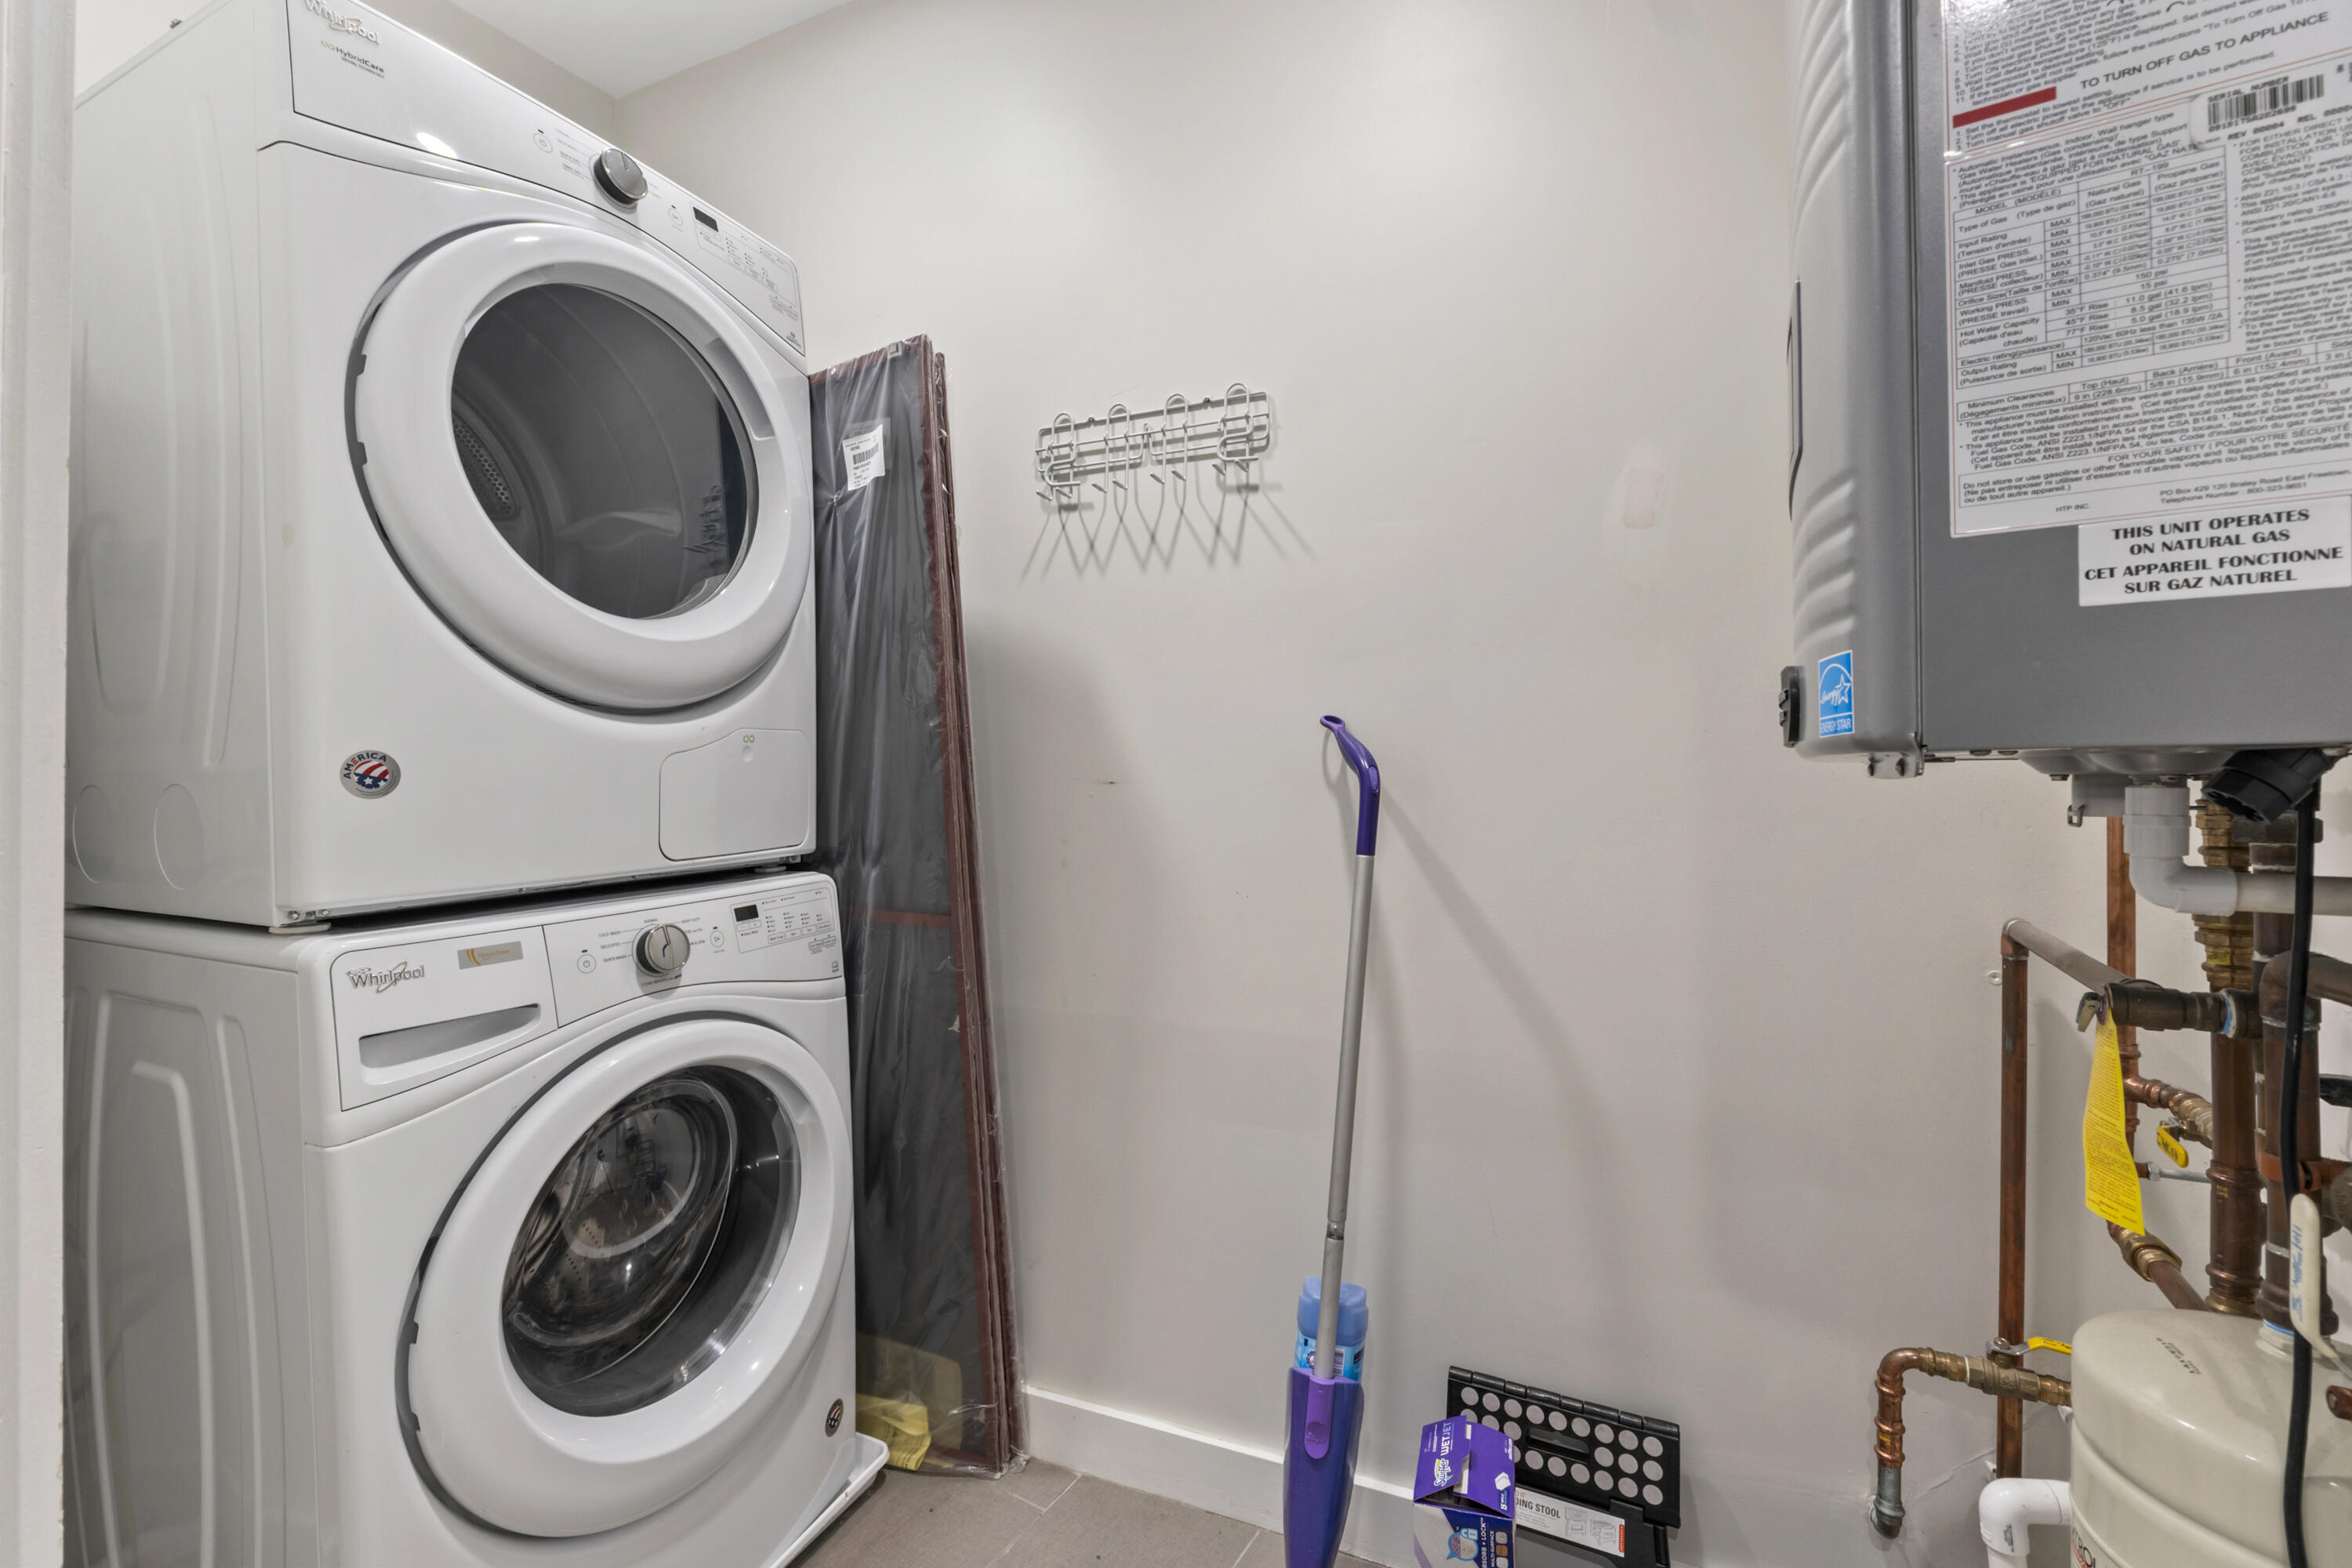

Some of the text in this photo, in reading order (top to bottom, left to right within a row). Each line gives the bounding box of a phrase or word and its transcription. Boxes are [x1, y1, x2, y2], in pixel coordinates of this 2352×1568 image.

[2081, 13, 2328, 89] TO TURN OFF GAS TO APPLIANCE
[336, 46, 385, 74] HybridCare
[2208, 76, 2289, 103] SERIAL NUMBER
[2227, 131, 2247, 140] REV
[2050, 218, 2071, 228] MAX
[2050, 229, 2068, 238] MIN
[2050, 238, 2071, 249] MAX
[2051, 249, 2069, 258] MIN
[2051, 259, 2072, 269] MAX
[2051, 270, 2069, 278] MIN
[2135, 270, 2152, 281] 150
[2140, 281, 2151, 290] 15
[2052, 288, 2072, 298] MAX
[2052, 299, 2070, 307] MIN
[2089, 302, 2109, 310] Rise
[2089, 323, 2109, 332] Rise
[2056, 350, 2077, 359] MAX
[2112, 509, 2310, 539] THIS UNIT OPERATES
[2129, 529, 2290, 556] ON NATURAL GAS
[2085, 546, 2343, 580] CET APPAREIL FONCTIONNE
[2124, 569, 2298, 593] SUR GAZ NATUREL
[1837, 718, 1851, 730] STAR
[343, 752, 387, 779] AMERICA
[350, 964, 426, 989] Whirlpool
[1434, 1458, 1452, 1486] Swiffer
[1535, 1503, 1561, 1519] STOOL
